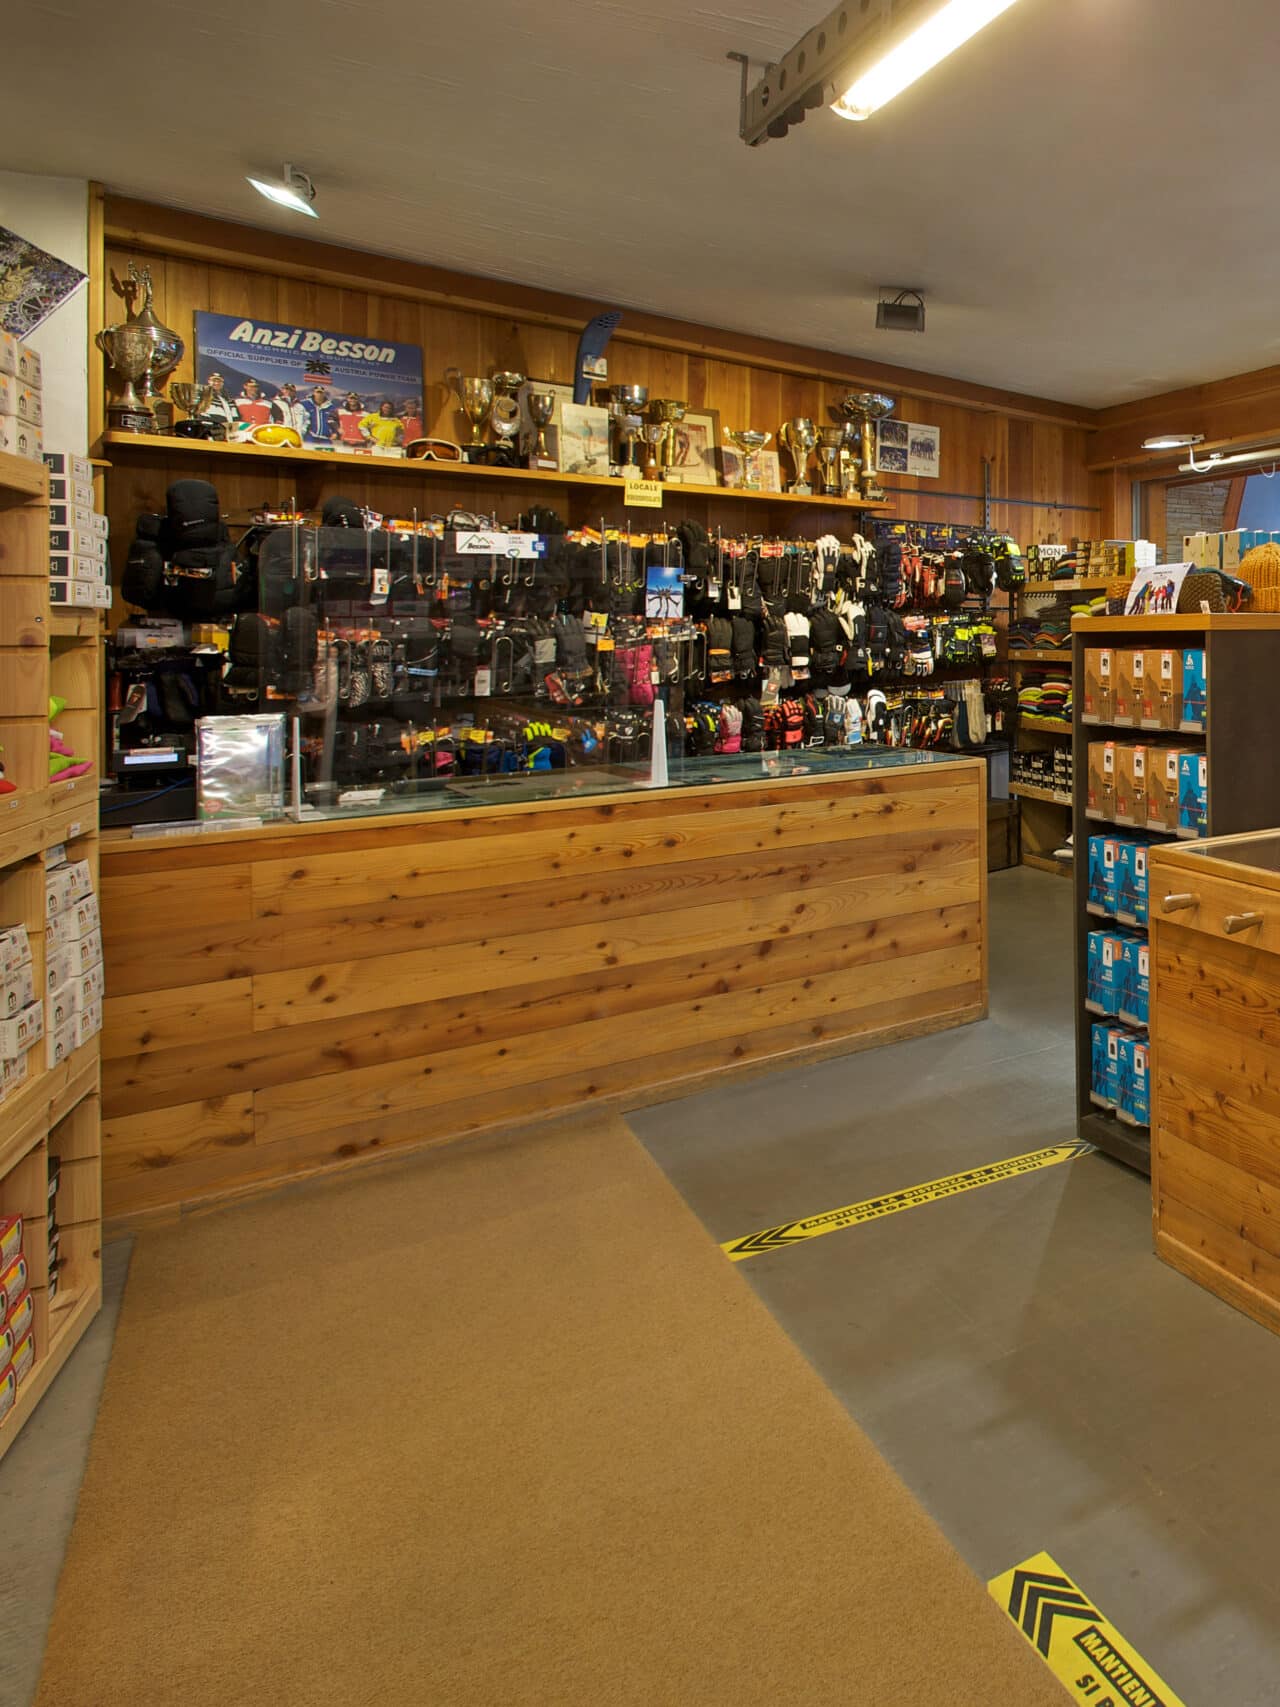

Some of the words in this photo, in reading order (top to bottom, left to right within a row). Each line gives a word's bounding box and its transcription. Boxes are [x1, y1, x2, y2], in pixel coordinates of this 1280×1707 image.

[206, 348, 245, 360] OFFICIAL
[247, 354, 289, 366] SUPPLIER
[334, 367, 367, 377] AUSTRIA
[229, 321, 302, 349] Anzi
[300, 331, 396, 364] Besson
[804, 1203, 873, 1228] MANTIENI
[881, 1196, 898, 1206] LA
[904, 1177, 966, 1199] DISTANZA
[992, 1150, 1056, 1172] SICUREZZA
[855, 1202, 907, 1220] PREGA
[912, 1194, 929, 1203] DI
[934, 1169, 1014, 1197] ATTENDERE
[1017, 1161, 1043, 1172] QUI
[1075, 1674, 1101, 1696] SI
